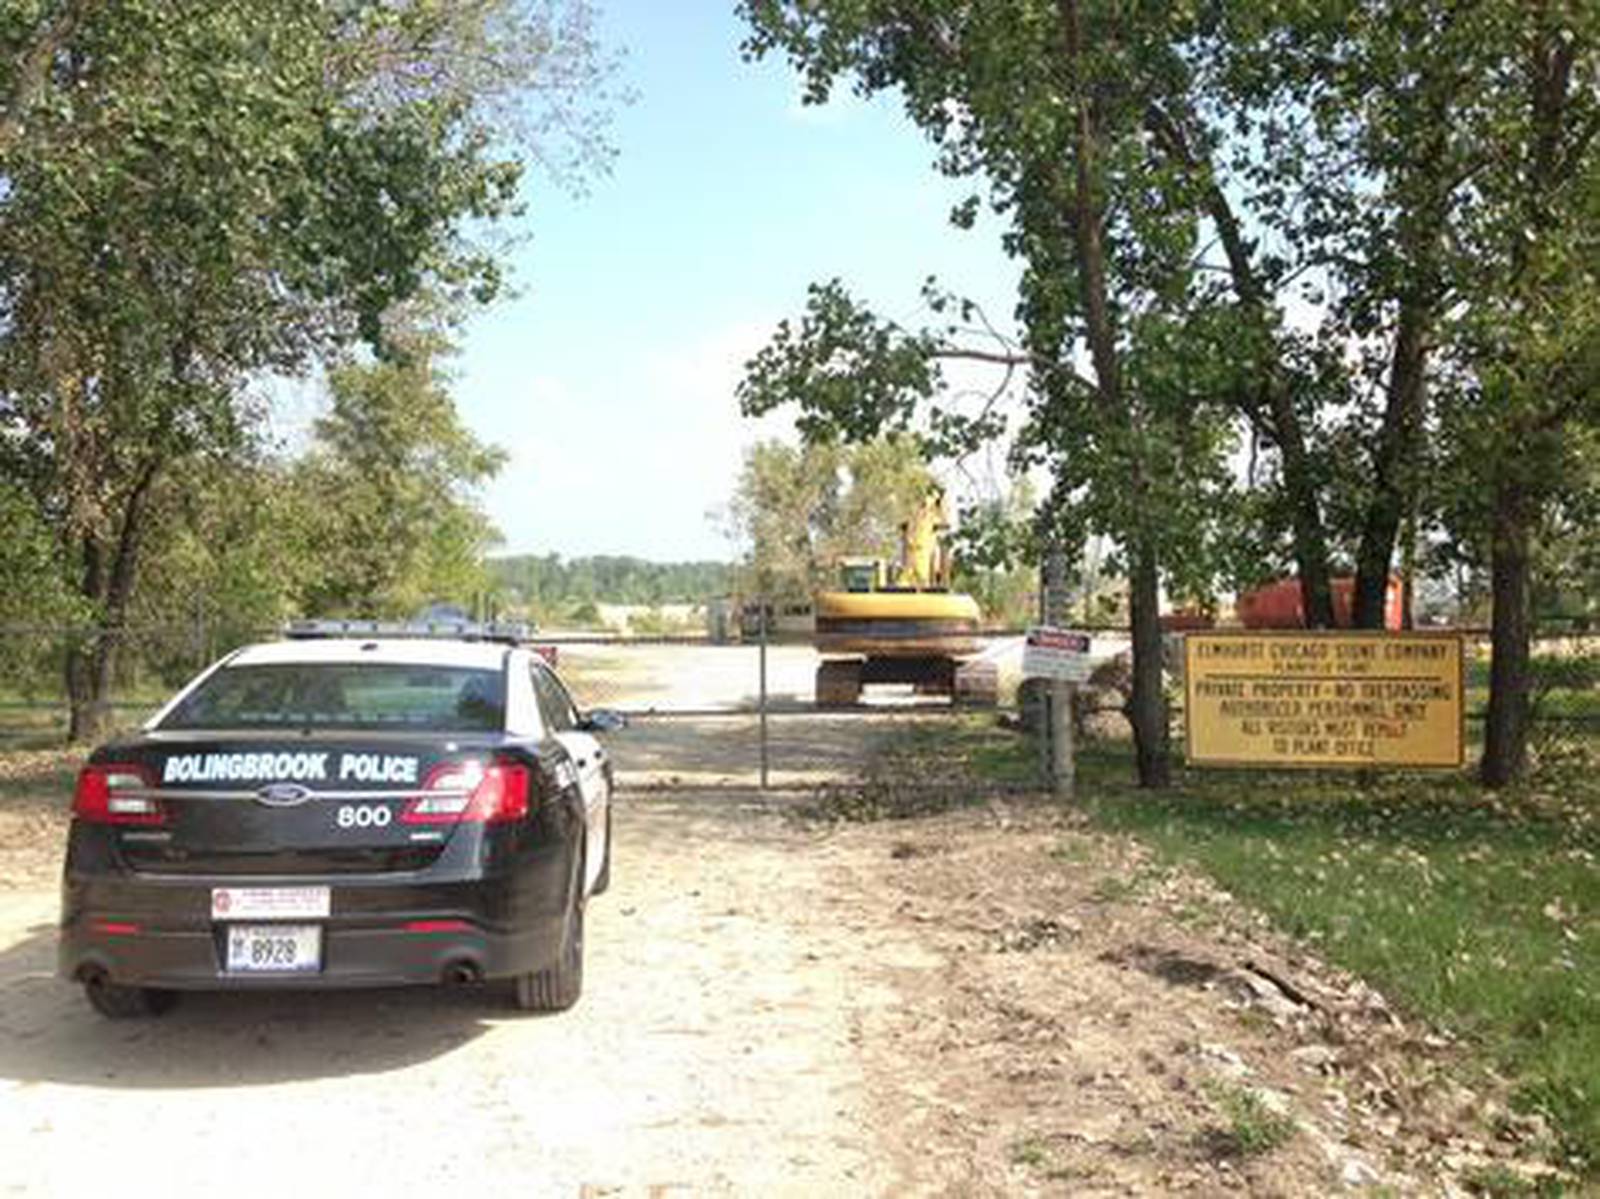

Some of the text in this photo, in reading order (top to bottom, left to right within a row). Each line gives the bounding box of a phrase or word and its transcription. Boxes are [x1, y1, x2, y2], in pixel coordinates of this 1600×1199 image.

[1270, 642, 1327, 660] CHICAGO
[1384, 643, 1447, 661] COMPANY
[1196, 682, 1245, 697] PRIVATE
[1252, 682, 1320, 697] PROPERTY
[1335, 683, 1356, 698] NO
[1361, 683, 1453, 700] TRESPASSING
[1219, 701, 1428, 720] AUTHORIZED PERSONNEL ONLY
[1241, 720, 1263, 735] ALL
[1268, 720, 1320, 735] VISITORS
[1325, 721, 1357, 736] MUST
[1273, 740, 1376, 755] TO PLANT OFFICE
[164, 754, 419, 782] BOLINGBROOK POLICE
[337, 806, 391, 827] 800
